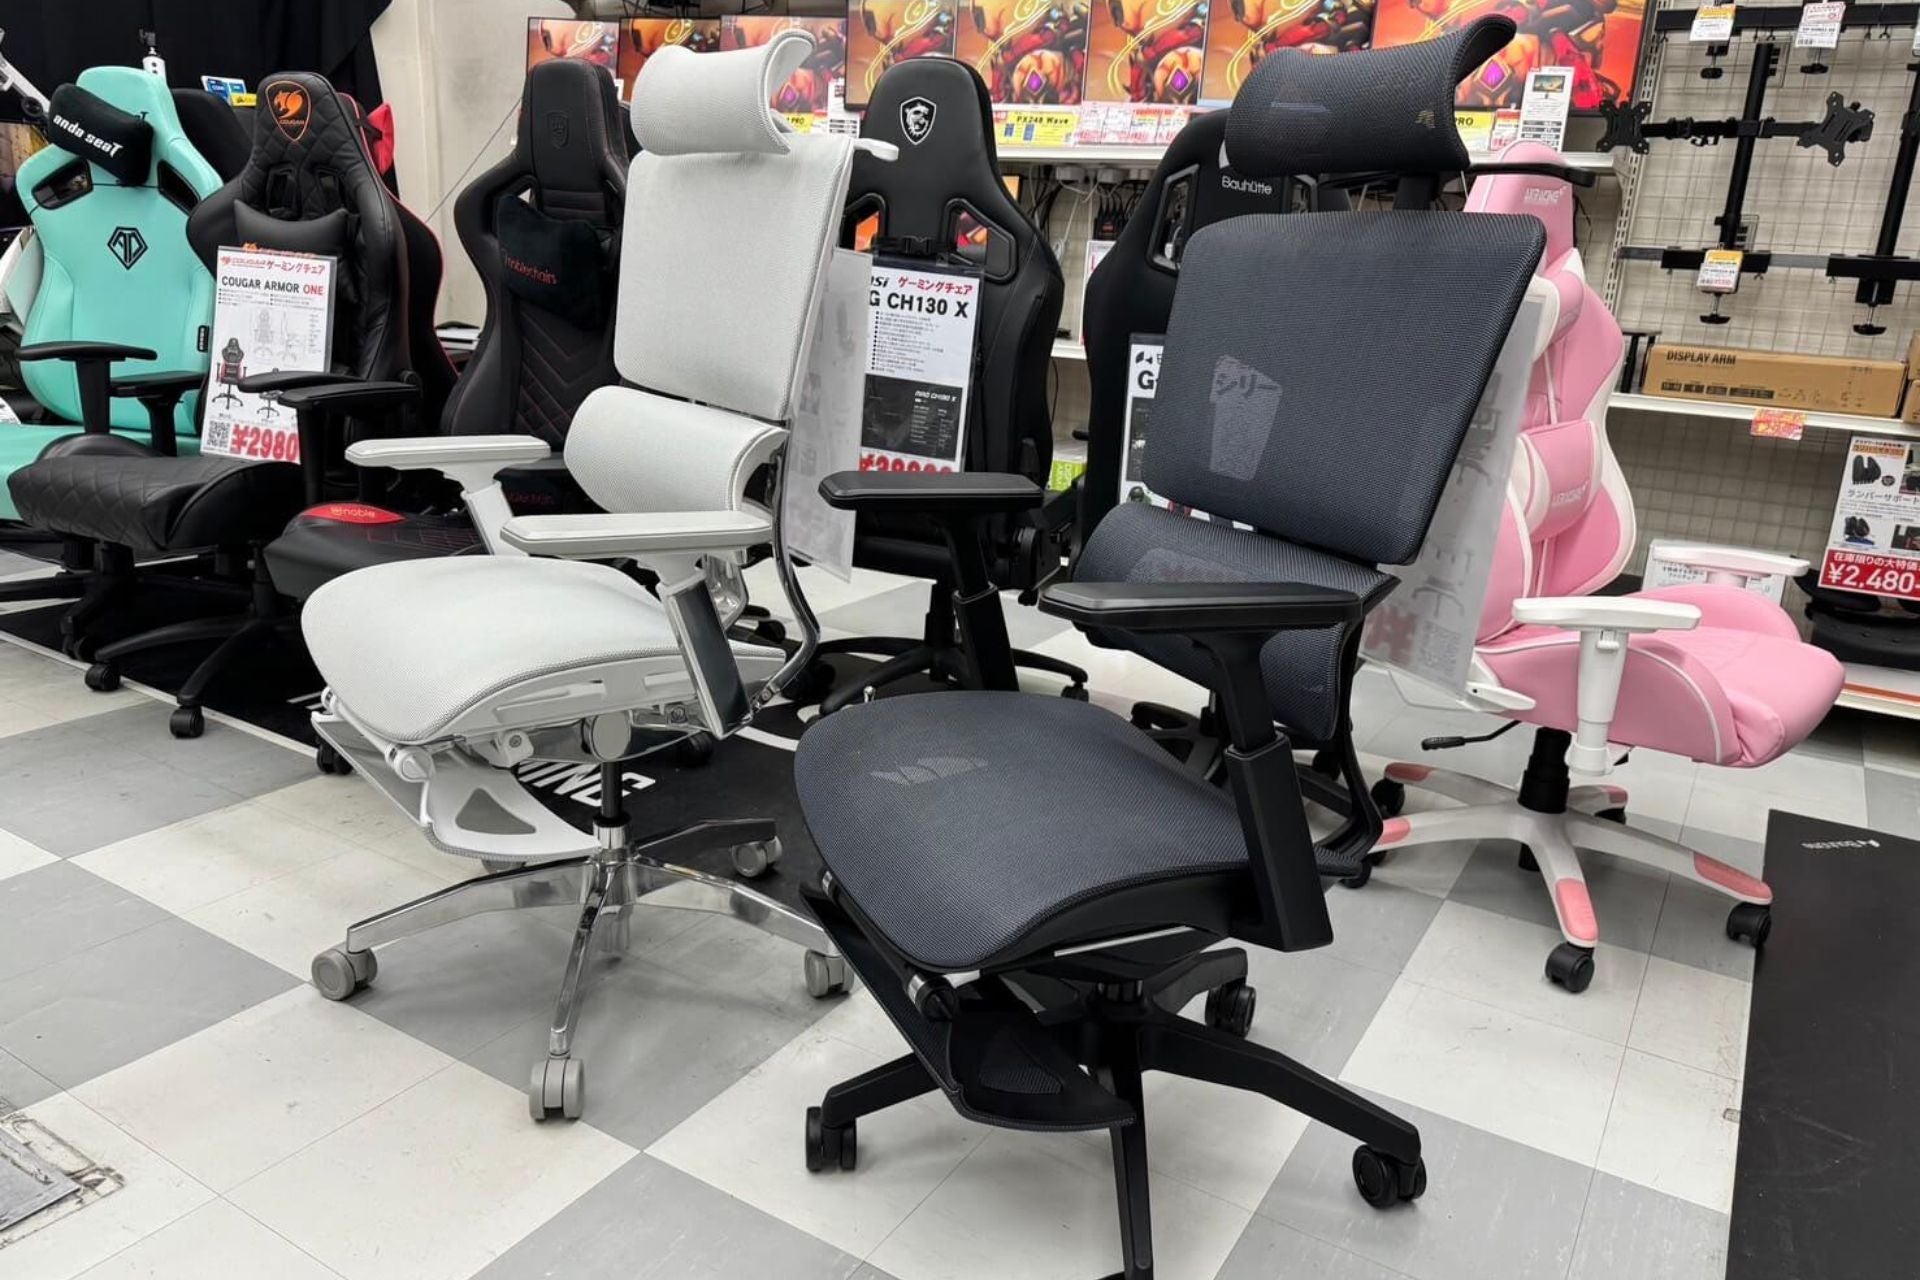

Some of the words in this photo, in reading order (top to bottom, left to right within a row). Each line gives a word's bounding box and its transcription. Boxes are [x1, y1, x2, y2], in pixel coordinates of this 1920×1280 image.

[53, 114, 84, 138] anda
[1221, 175, 1273, 195] Bauhütte
[221, 275, 261, 289] COUGAR
[263, 280, 300, 293] ARMOR
[302, 284, 325, 295] ONE
[898, 275, 974, 295] ゲーミングチェア
[887, 292, 948, 315] CH130
[954, 300, 969, 318] X
[1666, 350, 1711, 361] DISPLAY
[1711, 354, 1737, 365] ARM
[1847, 488, 1920, 505] ランバーサポート
